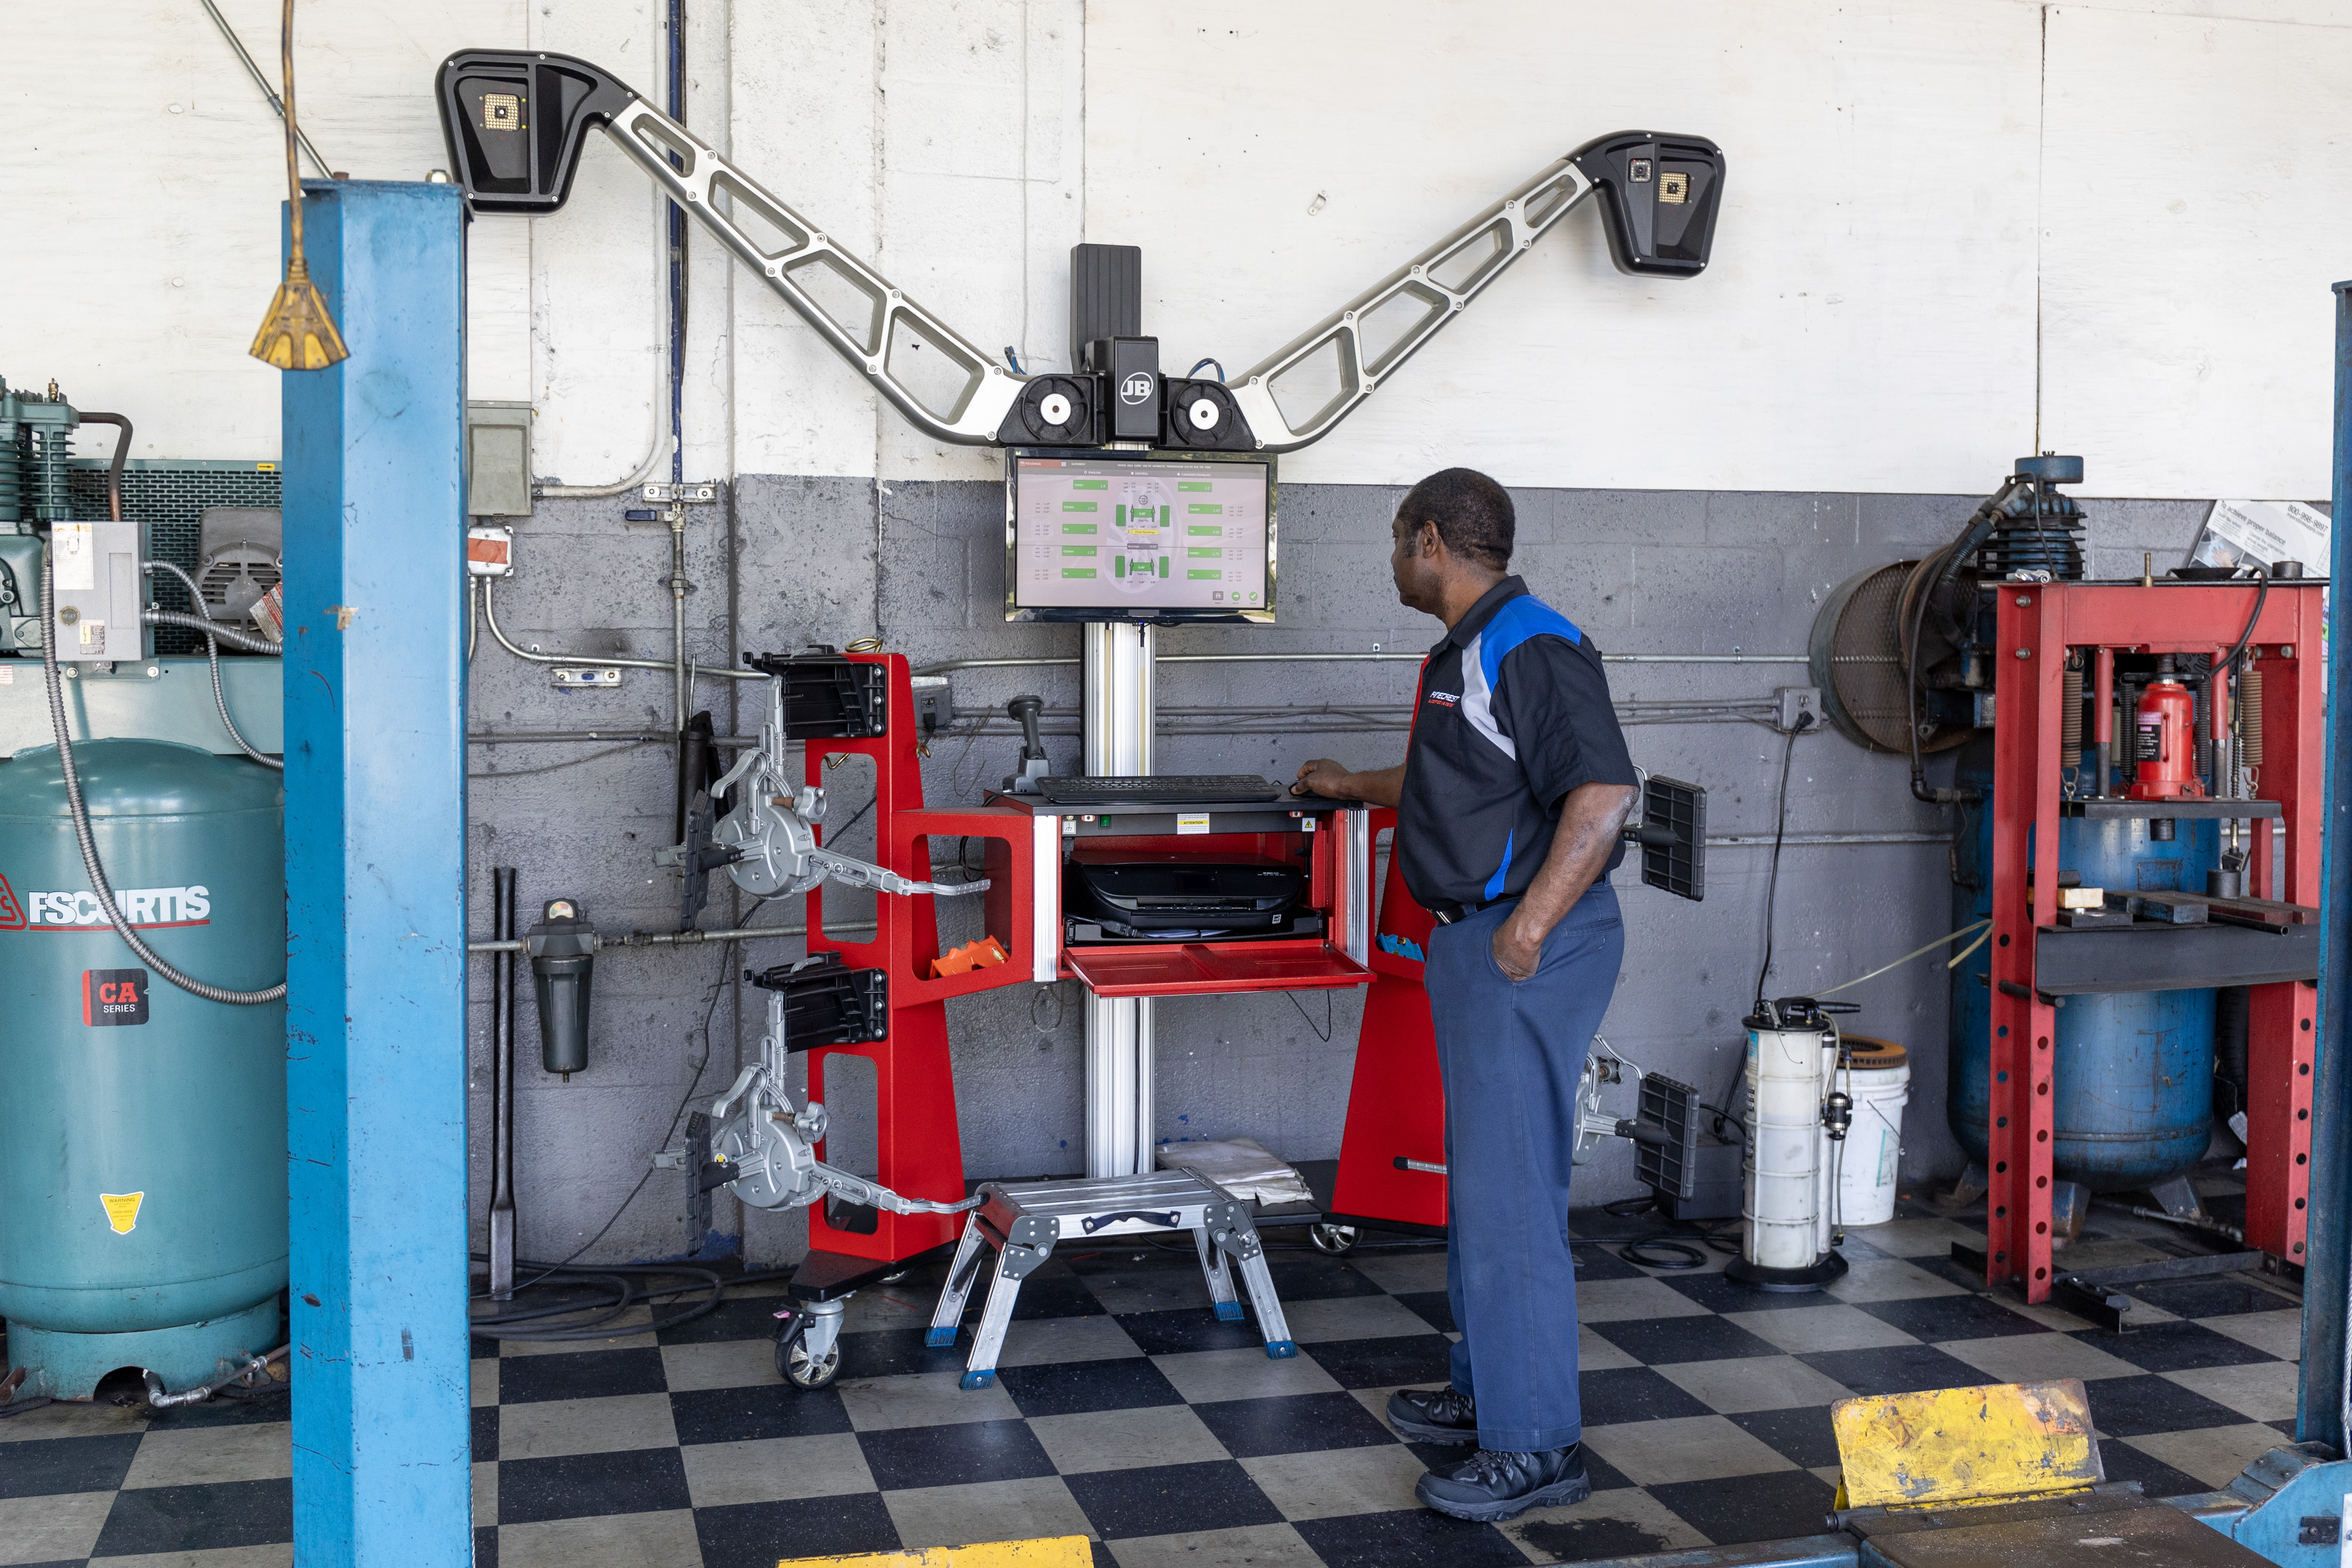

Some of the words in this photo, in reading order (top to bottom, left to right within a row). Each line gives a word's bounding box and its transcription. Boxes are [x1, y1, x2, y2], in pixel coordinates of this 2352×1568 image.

[1121, 380, 1151, 396] JB
[2226, 505, 2248, 521] achieve
[2246, 518, 2265, 532] proper
[2264, 529, 2287, 545] balance
[2286, 504, 2329, 532] 800-998-9897
[99, 982, 139, 1004] CA
[103, 1004, 136, 1013] SERIES
